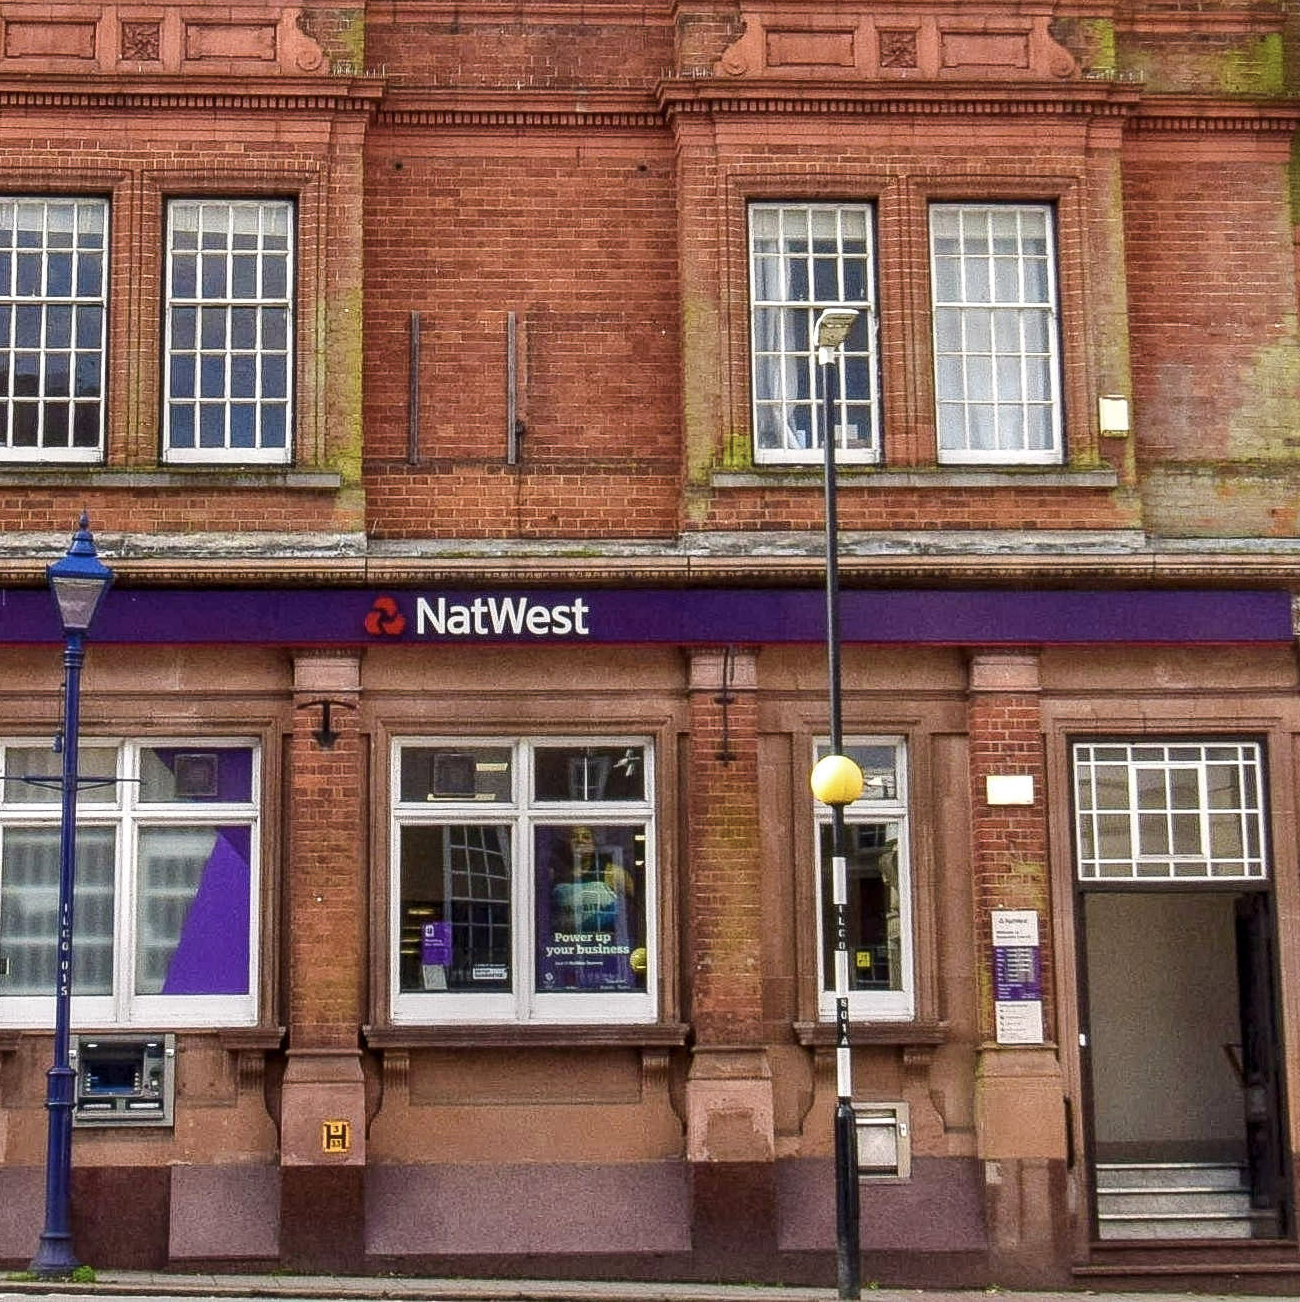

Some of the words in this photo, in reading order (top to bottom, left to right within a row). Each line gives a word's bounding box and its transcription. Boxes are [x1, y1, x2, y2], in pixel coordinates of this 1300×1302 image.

[416, 597, 589, 635] NatWest
[554, 933, 593, 942] Power
[596, 934, 611, 944] up
[546, 946, 575, 957] your
[577, 944, 630, 955] business
[326, 1124, 346, 1149] H
